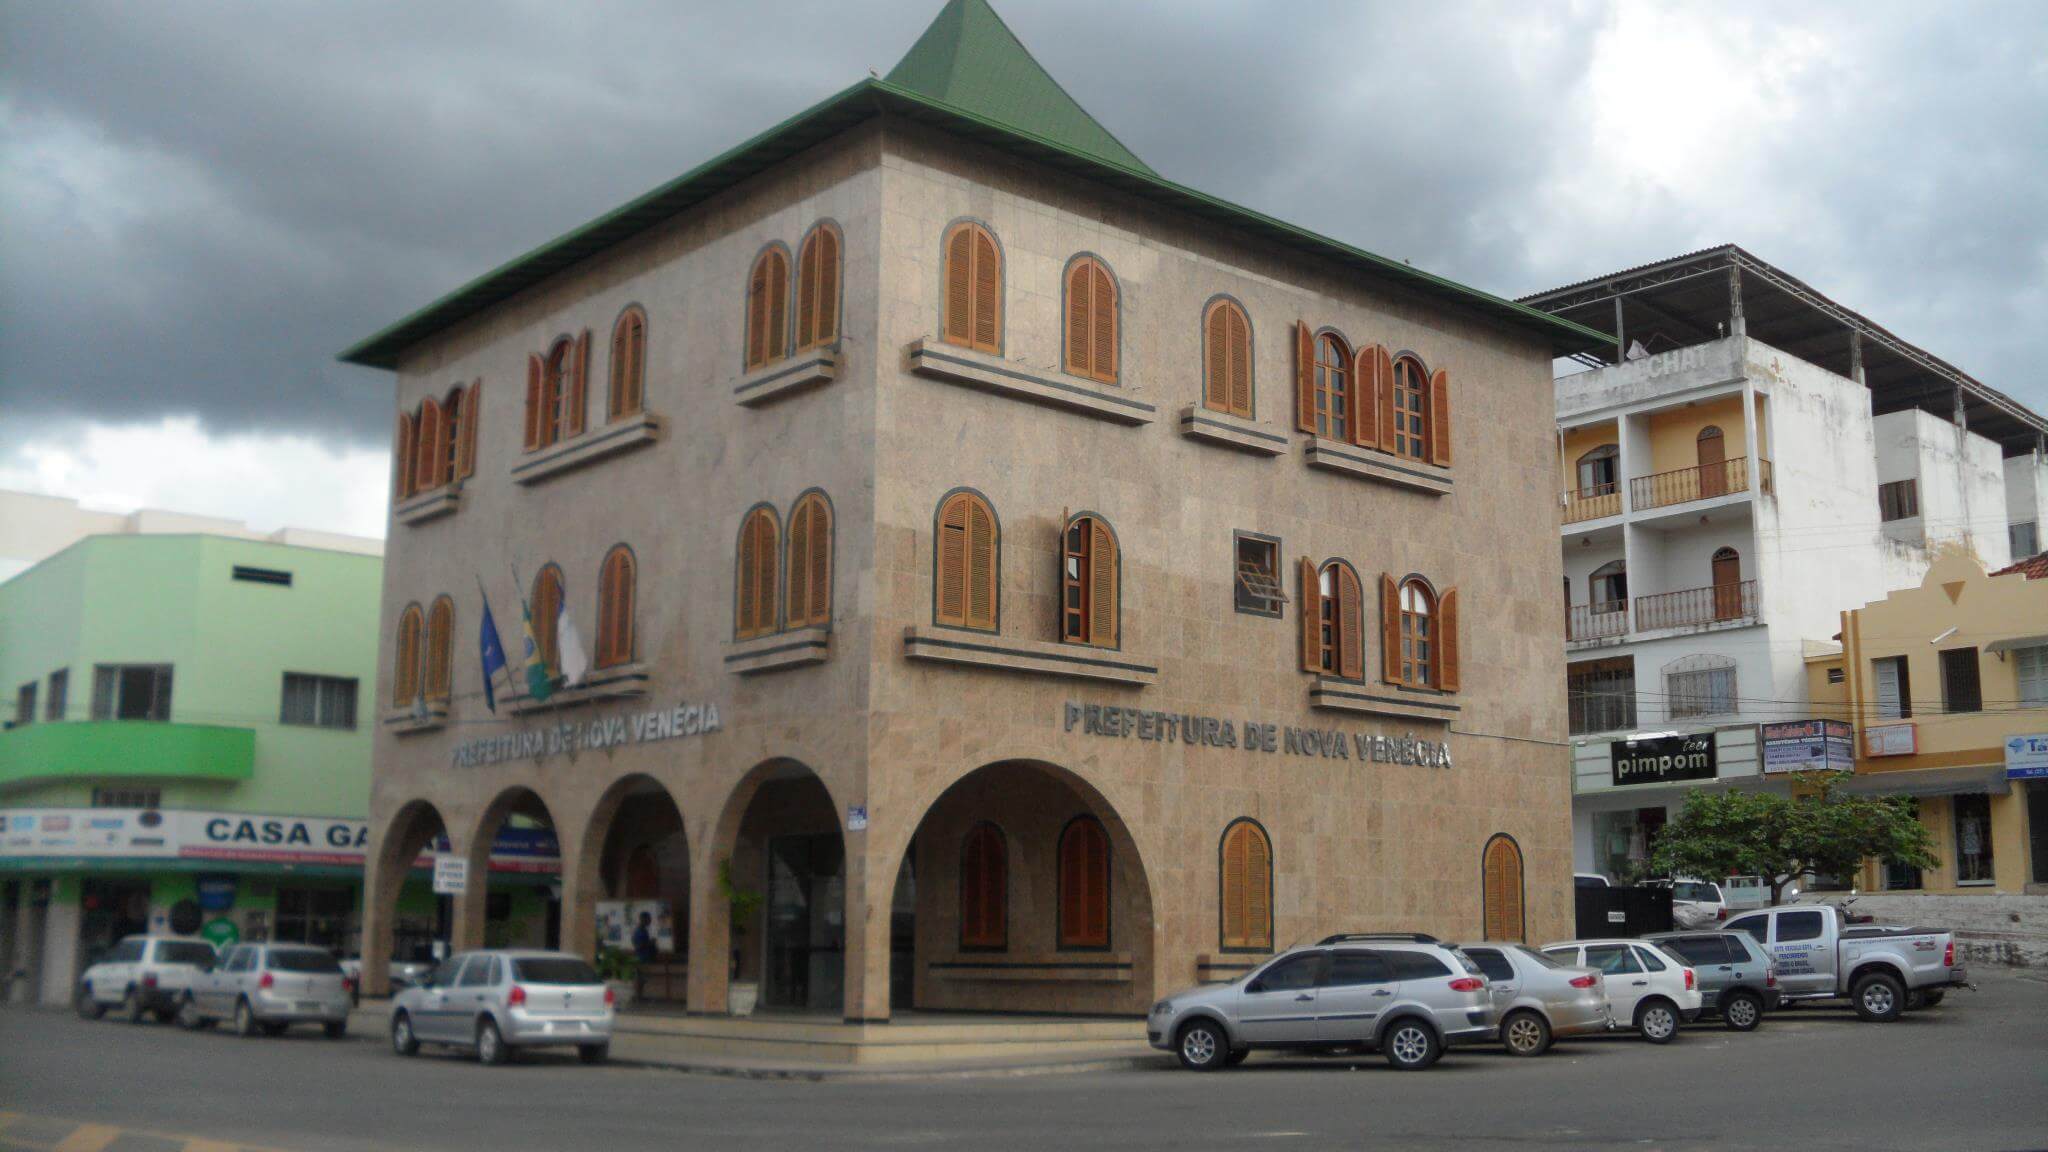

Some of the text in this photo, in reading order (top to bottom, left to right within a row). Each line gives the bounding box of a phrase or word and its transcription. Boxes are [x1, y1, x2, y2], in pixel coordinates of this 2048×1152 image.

[631, 701, 720, 743] VENÉCIA
[1064, 701, 1452, 769] PREFEITURA DE NOVA VENÉCIA
[1617, 752, 1708, 779] pimpom
[205, 818, 311, 845] CASA
